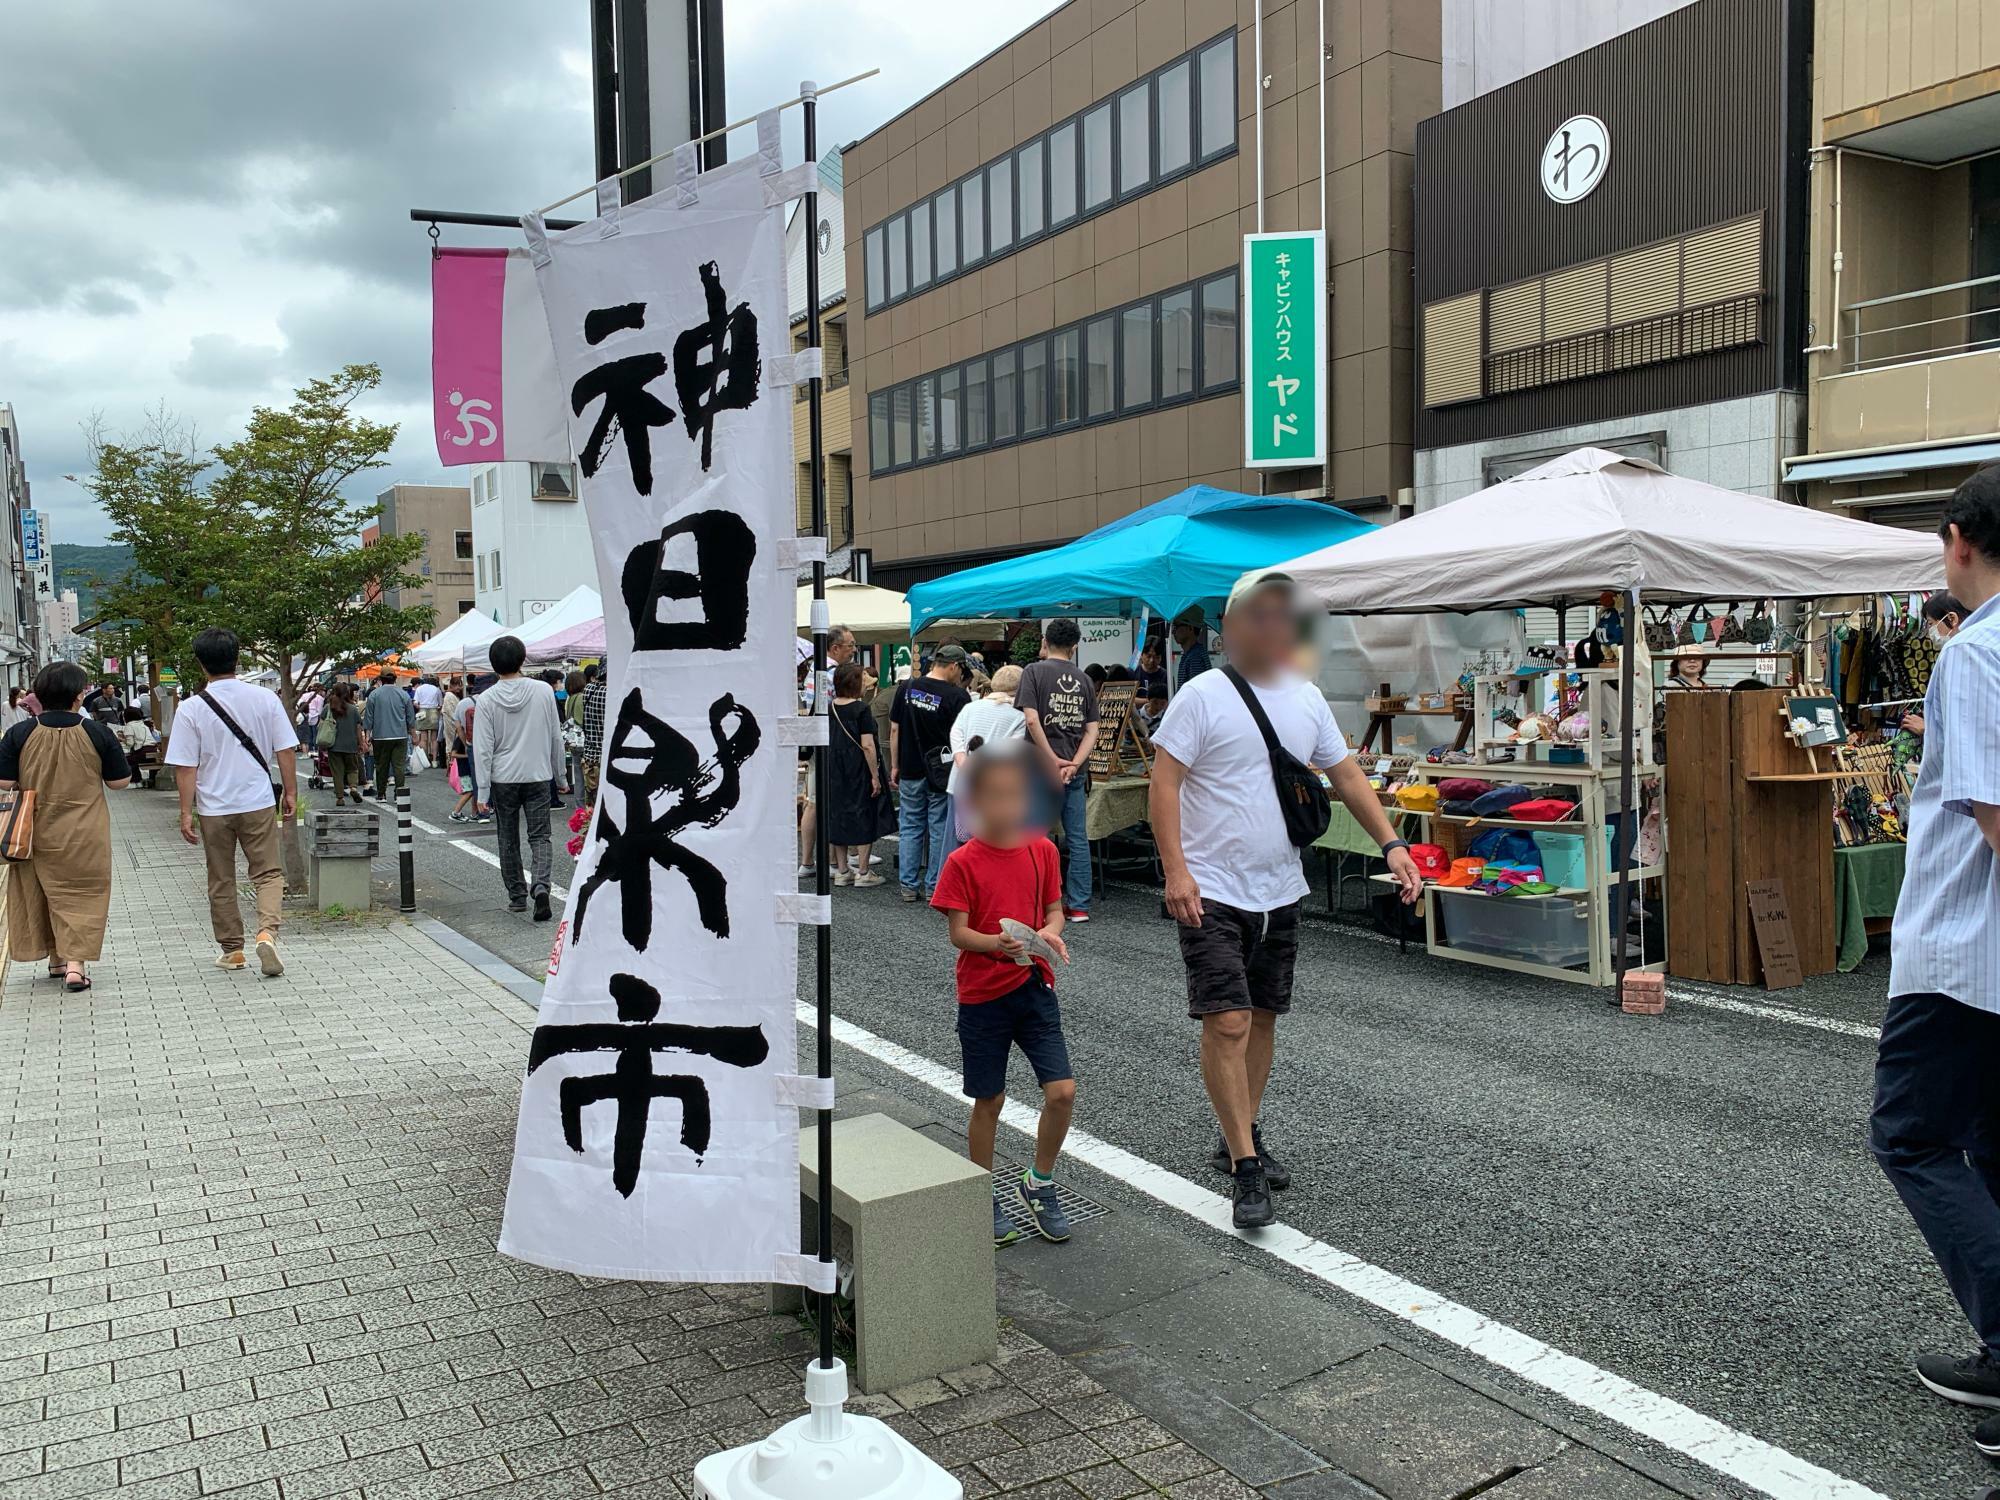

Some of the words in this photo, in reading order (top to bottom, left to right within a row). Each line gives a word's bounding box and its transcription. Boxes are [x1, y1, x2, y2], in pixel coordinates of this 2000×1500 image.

[1553, 130, 1600, 192] わ
[1275, 252, 1293, 361] キャビンハウス
[1267, 374, 1300, 447] ヤド
[1050, 692, 1084, 706] SMILEY
[1054, 702, 1079, 714] CLUB
